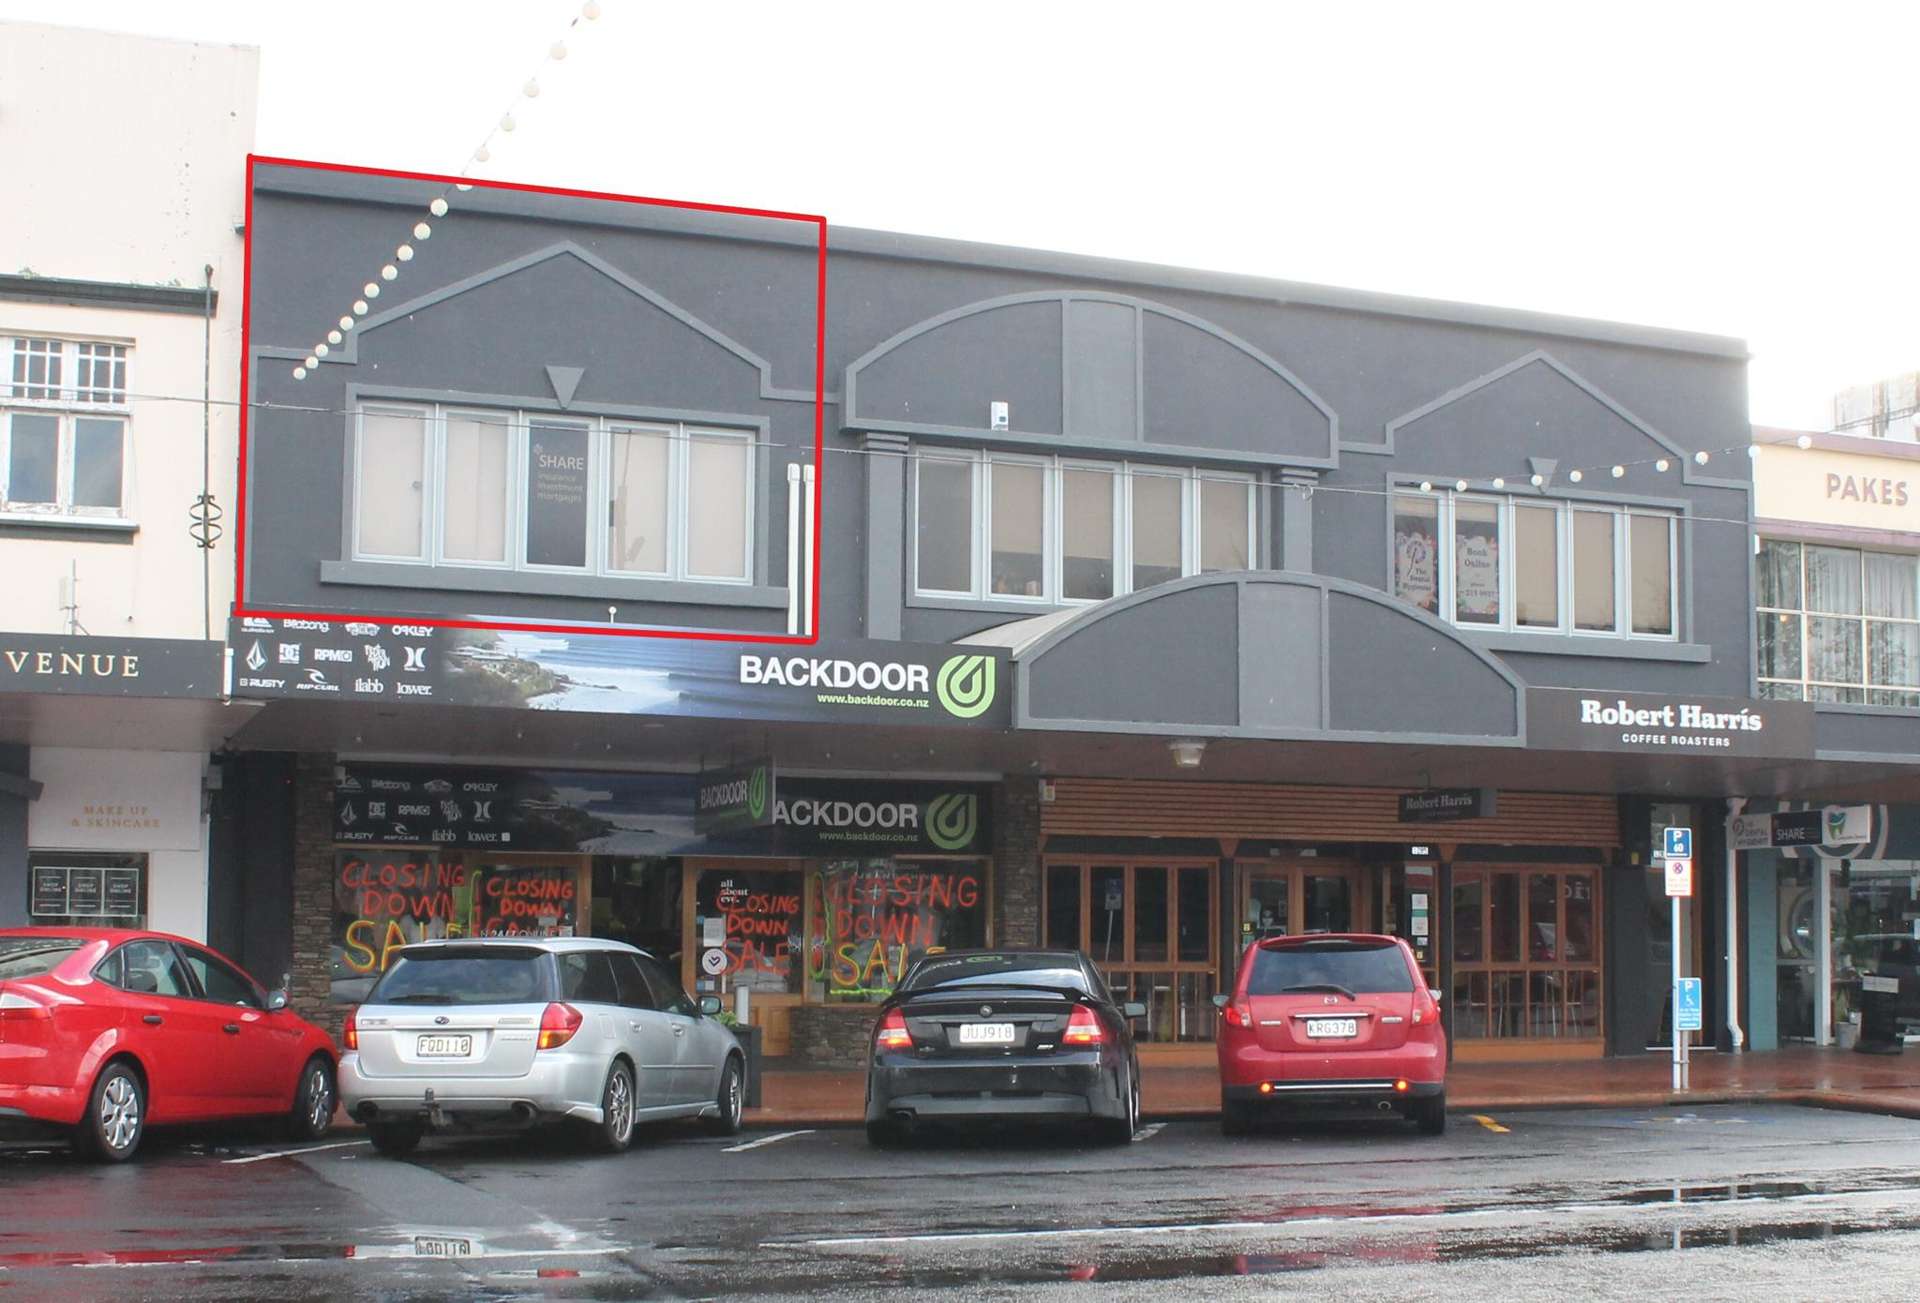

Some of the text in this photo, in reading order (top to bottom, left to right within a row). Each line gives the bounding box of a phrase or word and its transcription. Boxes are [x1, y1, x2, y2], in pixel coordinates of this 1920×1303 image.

[538, 455, 584, 470] SHARE
[1826, 473, 1909, 506] PAKES
[391, 625, 434, 637] OAKLEY
[4, 650, 139, 677] VENUE
[740, 655, 930, 692] BACKDOOR
[249, 678, 285, 688] RUSTY
[354, 678, 384, 693] ilabb
[817, 693, 929, 708] www.backdoor.co.nz
[1580, 699, 1675, 728] Robert
[1622, 733, 1730, 747] COFFEE ROASTERS
[700, 780, 748, 809] BACKDOOR
[1406, 796, 1440, 809] Robert
[83, 806, 150, 816] MAKE UP
[772, 800, 919, 829] ACKDOOR
[87, 818, 161, 829] SKINCARE
[819, 831, 919, 842] www.backdoor.co.nz
[1673, 830, 1682, 842] P
[1776, 827, 1806, 841] SHARE
[341, 861, 465, 889] CLOSING
[486, 877, 576, 900] CLOSING
[720, 879, 733, 888] all
[827, 874, 978, 908] CLOSING
[362, 889, 457, 919] DOWN
[500, 899, 565, 917] DOWN
[715, 893, 800, 914] CLOSING
[727, 912, 789, 936] DOWN
[837, 908, 936, 946] DOWN
[719, 937, 791, 977] SALE
[963, 1026, 1013, 1040] JUJ918
[1308, 1022, 1356, 1035] KRG378
[419, 1036, 469, 1052] FQD110
